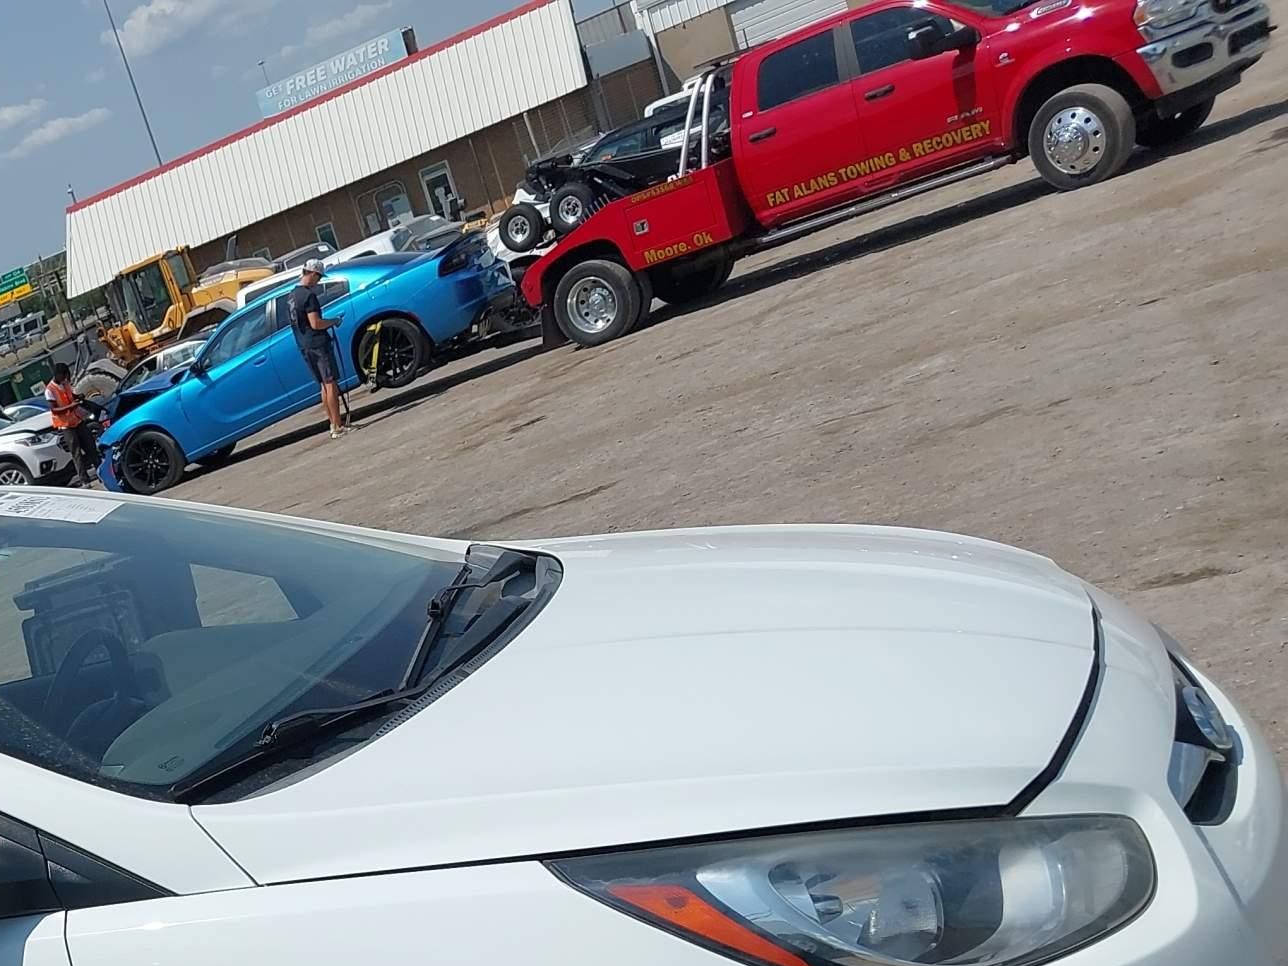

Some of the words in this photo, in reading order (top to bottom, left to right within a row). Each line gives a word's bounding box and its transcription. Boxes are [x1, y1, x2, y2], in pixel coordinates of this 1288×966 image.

[265, 83, 283, 98] GET
[285, 66, 328, 96] FREE
[327, 37, 390, 75] WATER
[278, 96, 299, 110] FOR
[300, 83, 328, 101] LAWN
[328, 57, 386, 88] IRRIGATION
[766, 188, 791, 207] FAT
[794, 172, 839, 199] ALANS
[839, 152, 896, 183] TOWING
[898, 147, 912, 162] &
[912, 120, 991, 158] RECOVERY
[693, 231, 713, 247] Ok
